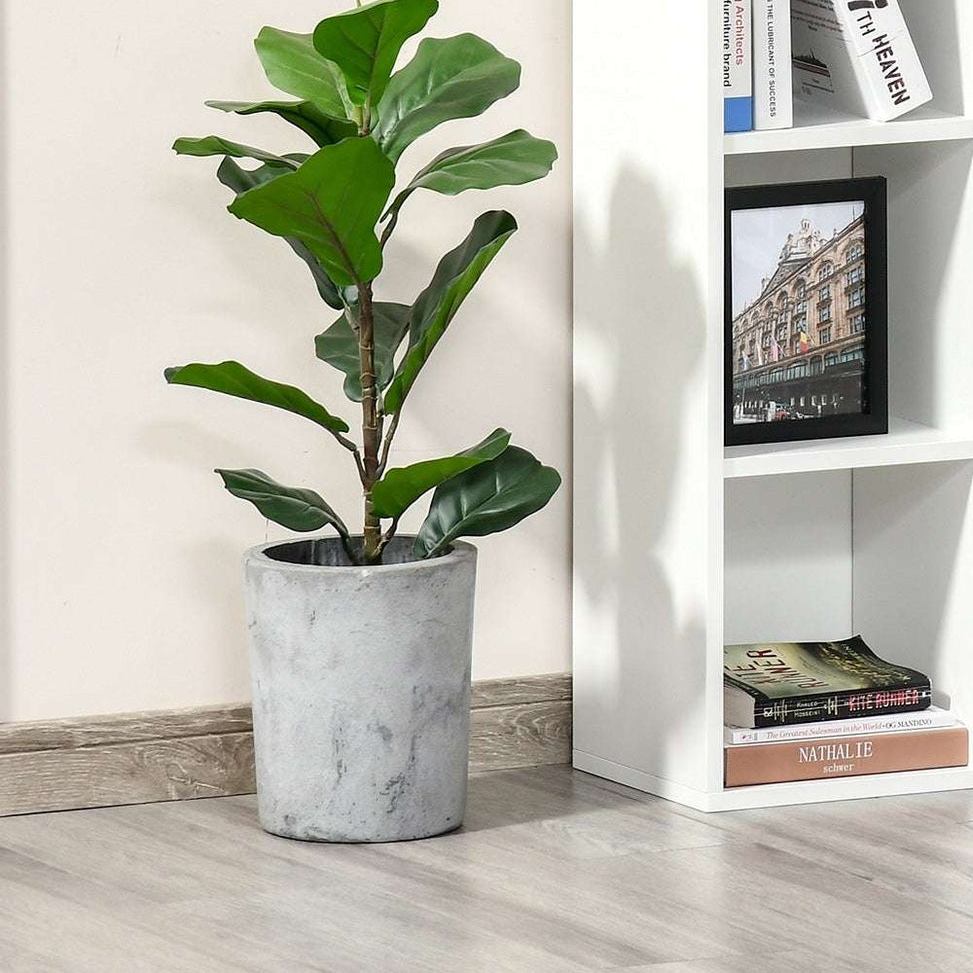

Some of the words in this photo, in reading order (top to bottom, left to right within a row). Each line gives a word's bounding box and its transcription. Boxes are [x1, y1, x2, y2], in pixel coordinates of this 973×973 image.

[723, 0, 732, 50] furniture
[735, 5, 745, 66] Architects
[767, 21, 775, 66] LUBRICANT
[723, 53, 732, 88] brand
[768, 68, 776, 77] OF
[857, 11, 876, 36] TH
[872, 34, 911, 106] HEAVEN
[848, 694, 873, 712] KITE
[875, 689, 920, 709] RUNNER
[798, 741, 873, 764] NATHALIE
